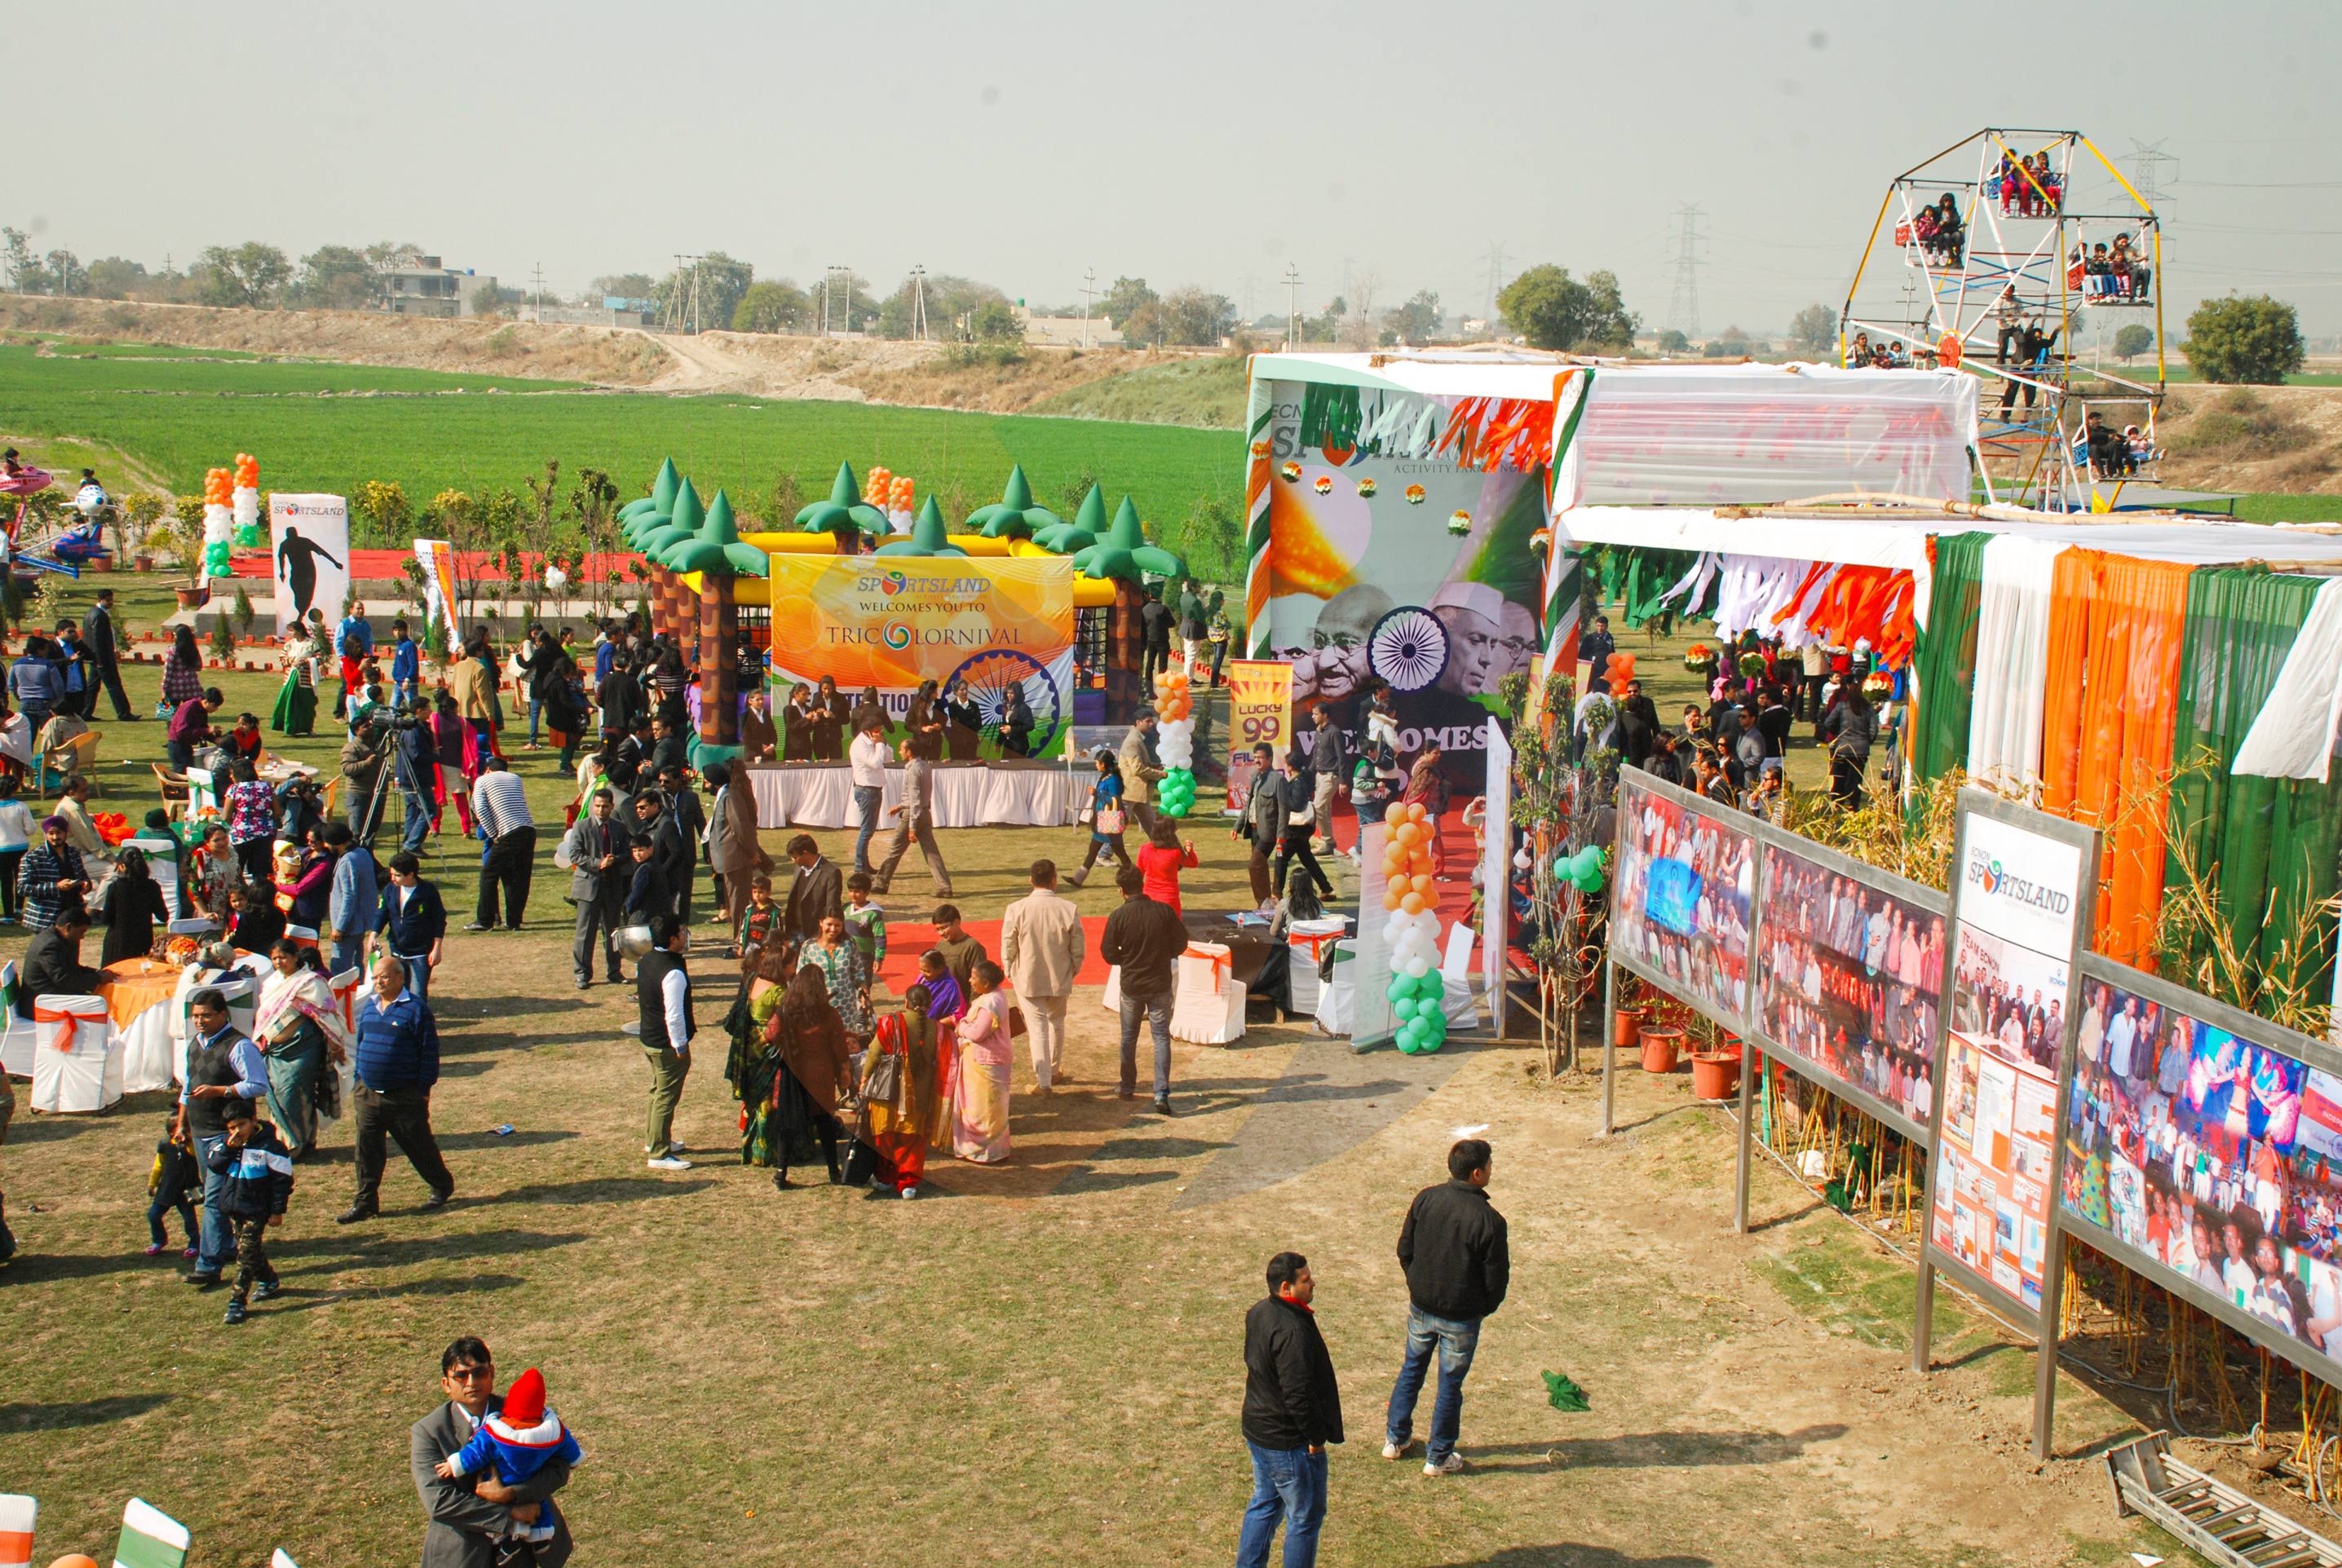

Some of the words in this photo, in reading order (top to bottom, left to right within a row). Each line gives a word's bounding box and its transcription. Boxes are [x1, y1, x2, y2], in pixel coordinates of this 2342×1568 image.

[1394, 464, 1452, 474] ACTIVITY
[274, 504, 344, 515] SPORTSLAND
[858, 574, 991, 595] SPORTSLAND
[859, 603, 931, 612] WELCOMES
[935, 603, 963, 612] YOU
[967, 603, 985, 612] TO
[1239, 704, 1282, 715] LUCKY
[1243, 715, 1279, 743] 99
[1969, 860, 2070, 915] SPORTSLAND
[1962, 930, 1979, 956] TEAM
